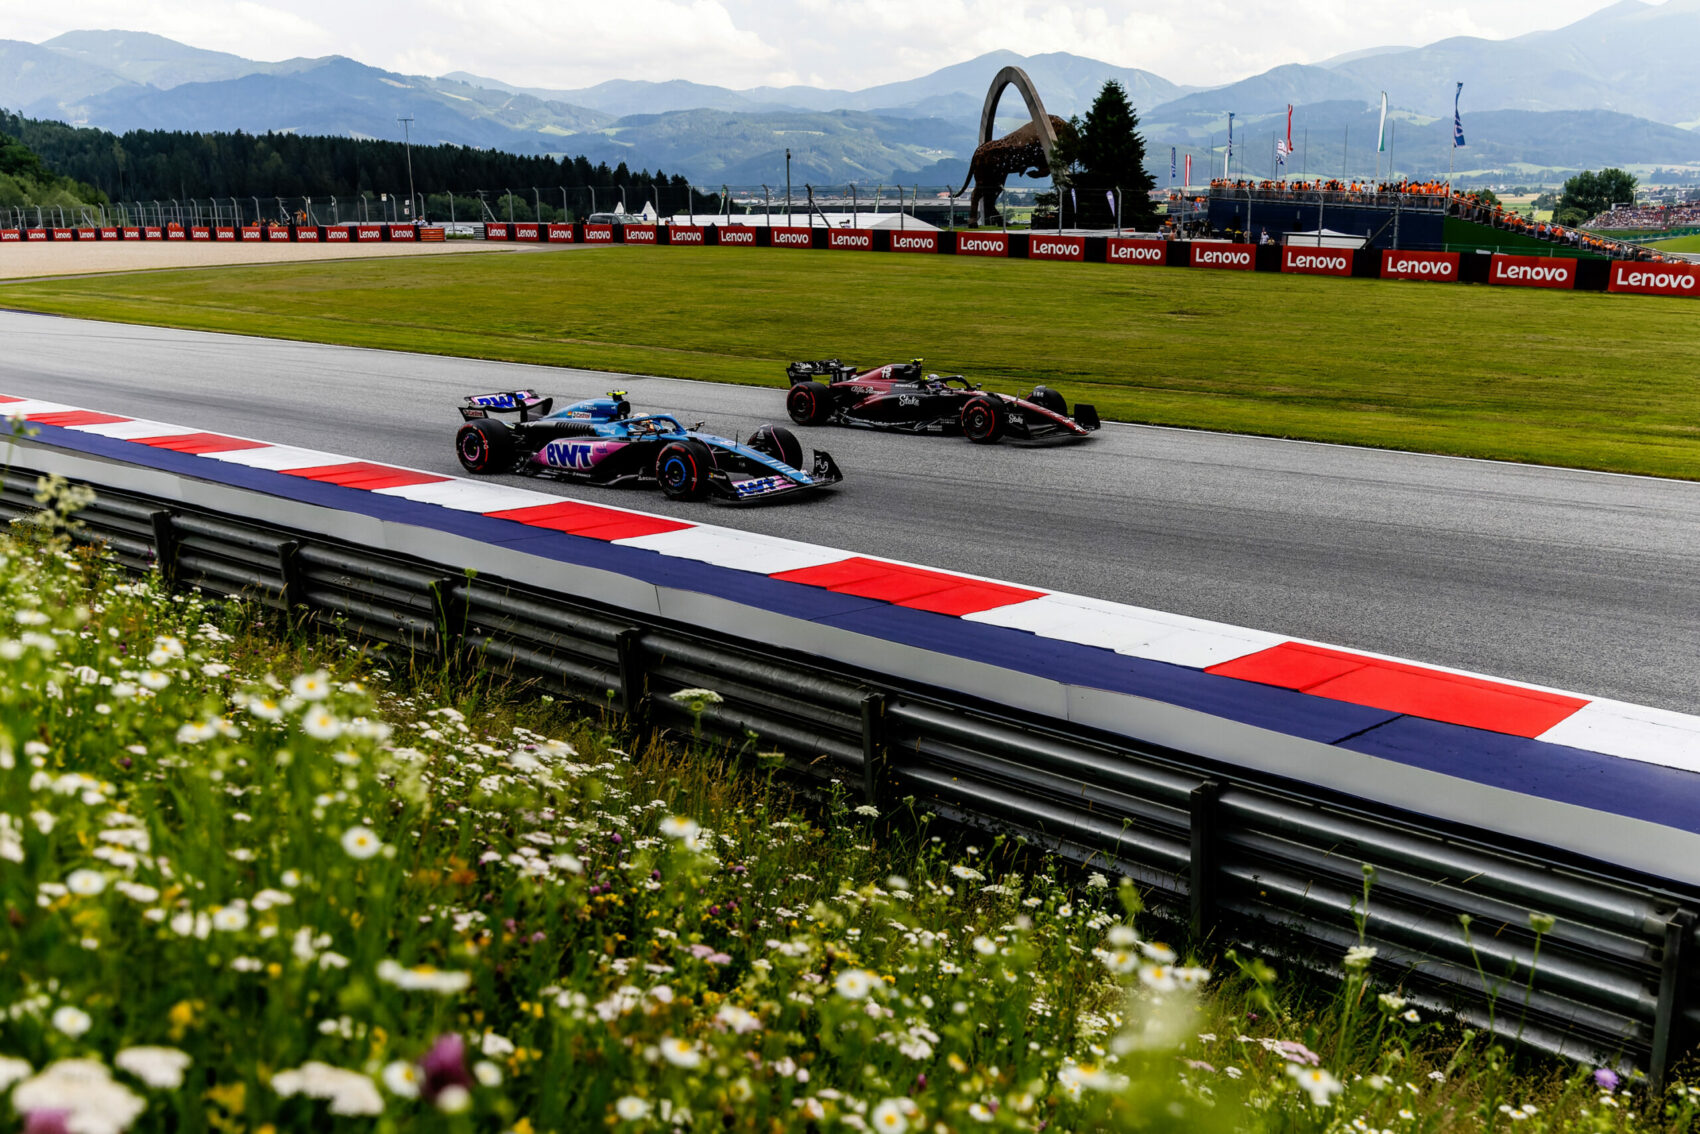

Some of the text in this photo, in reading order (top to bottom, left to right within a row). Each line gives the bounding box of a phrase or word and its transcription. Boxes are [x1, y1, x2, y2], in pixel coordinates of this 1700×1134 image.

[242, 230, 260, 239] Lenovo
[269, 230, 288, 239] Lenovo
[297, 230, 317, 239] Lenovo
[328, 229, 348, 239] Lenovo
[359, 229, 380, 239] Lenovo
[391, 228, 414, 238] Lenovo
[488, 228, 507, 237] Lenovo
[517, 228, 538, 238] Lenovo
[549, 228, 572, 239] Lenovo
[585, 228, 611, 239] Lenovo
[626, 228, 654, 240] Lenovo
[671, 230, 702, 242] Lenovo
[721, 230, 753, 243] Lenovo
[774, 231, 809, 244] Lenovo
[831, 231, 869, 246] Lenovo
[893, 234, 934, 249] Lenovo
[960, 237, 1004, 252] Lenovo
[1033, 240, 1080, 256] Lenovo
[1111, 243, 1162, 260] Lenovo
[1195, 247, 1250, 265] Lenovo
[1286, 251, 1347, 270] Lenovo
[1387, 256, 1453, 276] Lenovo
[1496, 261, 1569, 282] Lenovo
[1616, 268, 1696, 289] Lenovo
[899, 394, 920, 407] Stake
[546, 442, 594, 469] BWT
